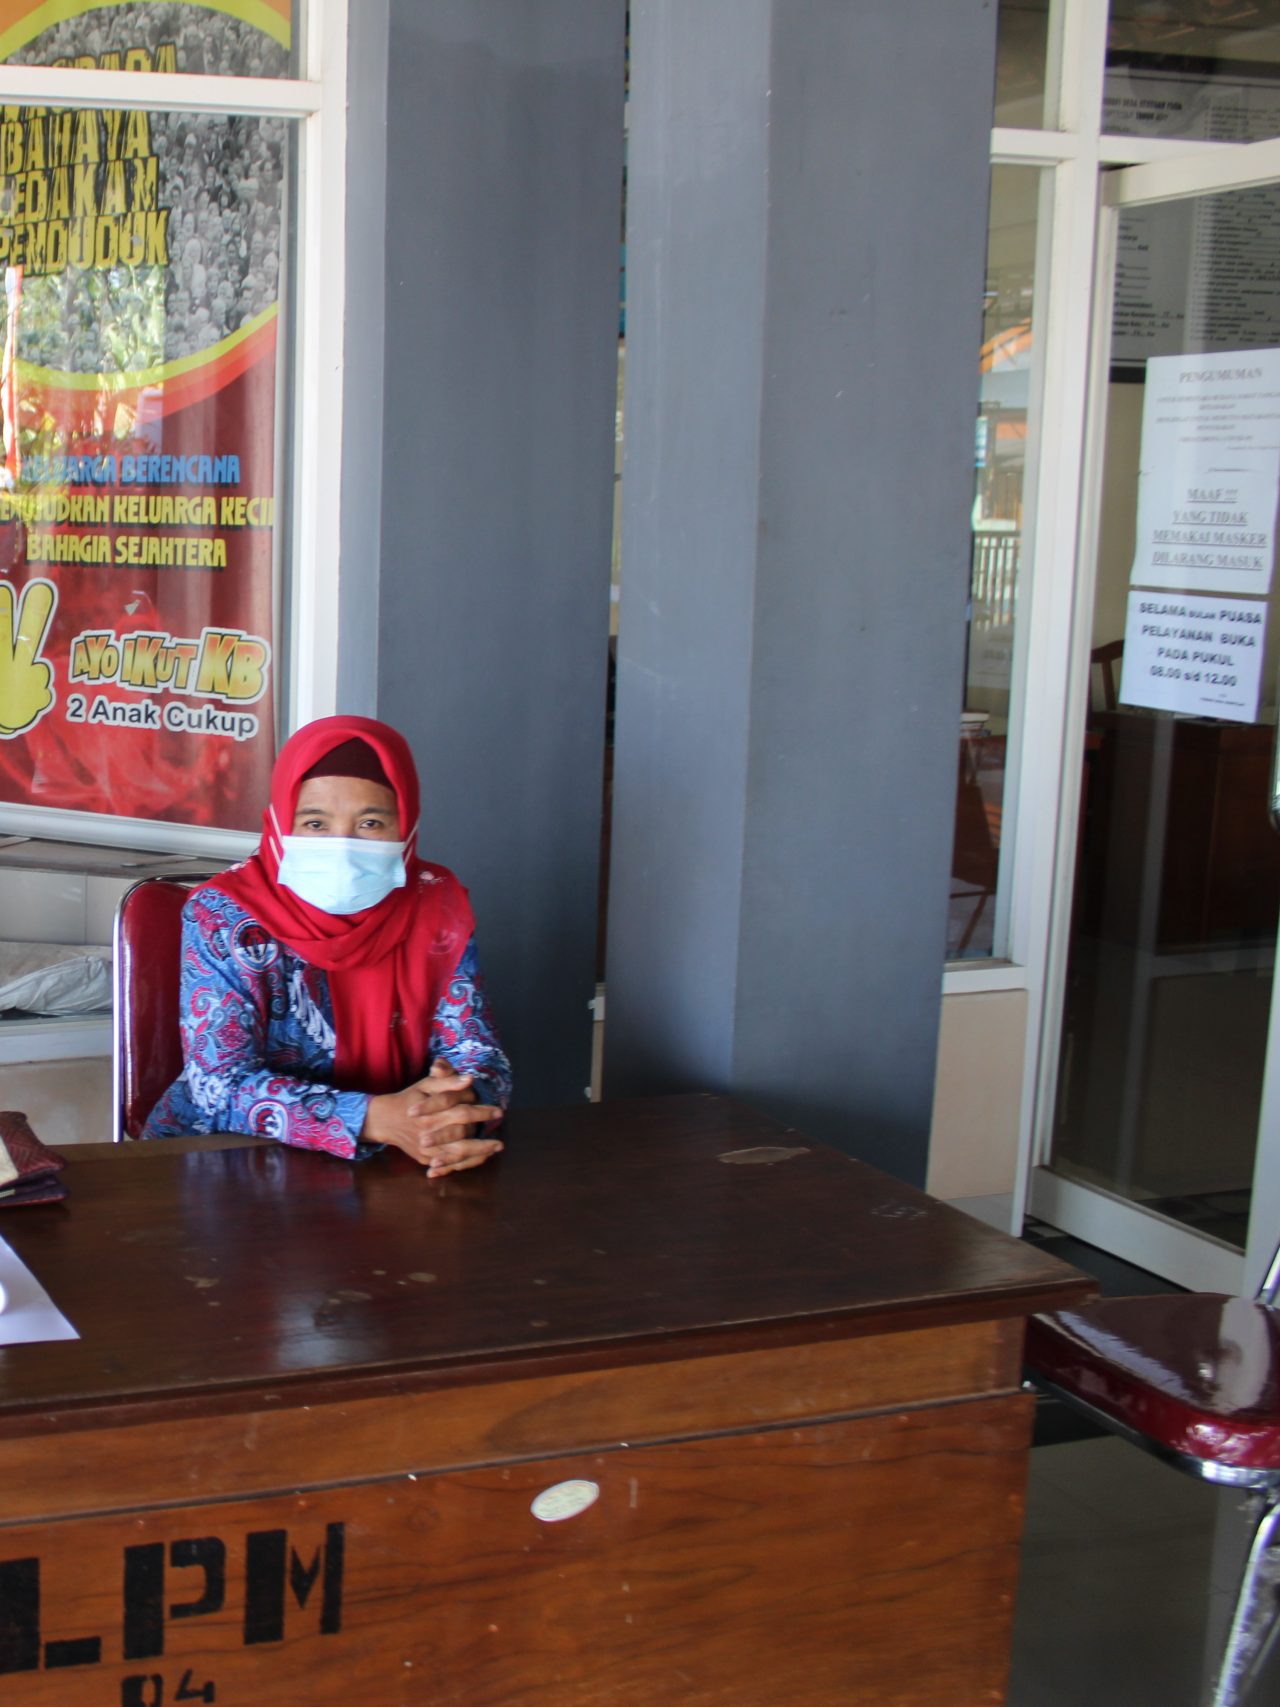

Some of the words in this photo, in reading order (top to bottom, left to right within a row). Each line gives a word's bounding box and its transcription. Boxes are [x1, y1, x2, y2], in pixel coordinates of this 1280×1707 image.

[21, 455, 117, 485] KELUARGA
[122, 455, 240, 485] BERENCANA
[113, 495, 217, 525] KELUARGA
[1172, 510, 1207, 524] YANG
[1209, 511, 1248, 525] TIDAK
[1213, 531, 1266, 547] MASKER
[26, 534, 112, 564] BAHAGIA
[115, 536, 227, 568] SEJAHTERA
[1152, 551, 1213, 567] DILARANG
[1216, 554, 1263, 570] MASUK
[1140, 602, 1186, 617] SELAMA
[1219, 609, 1262, 624] PUASA
[1142, 624, 1214, 642] PELAYANAN
[1220, 633, 1256, 647] BUKA
[195, 631, 268, 701] KB
[1157, 647, 1189, 661] PADA
[1192, 651, 1235, 667] PUKUL
[1204, 672, 1238, 687] 12.00
[70, 697, 84, 719] 2
[92, 702, 157, 726] Anak
[166, 704, 255, 738] Cukup
